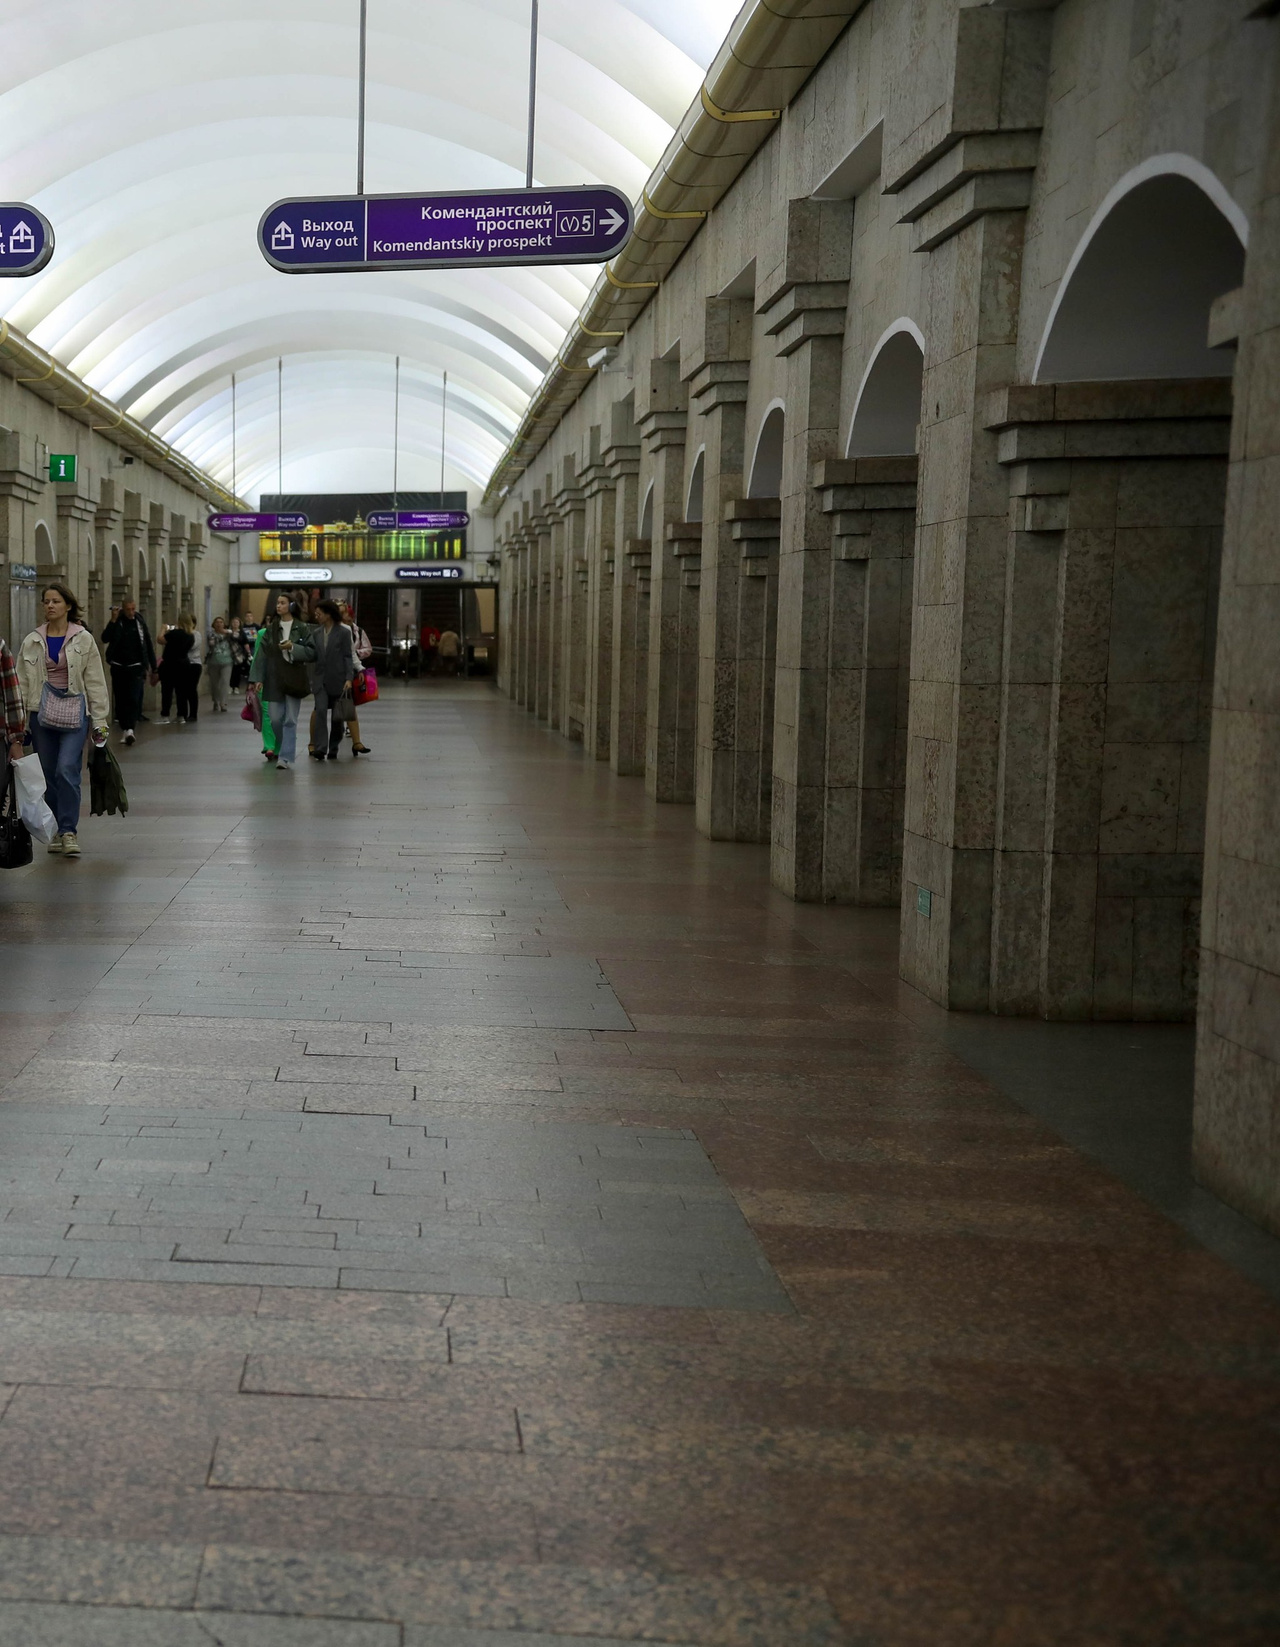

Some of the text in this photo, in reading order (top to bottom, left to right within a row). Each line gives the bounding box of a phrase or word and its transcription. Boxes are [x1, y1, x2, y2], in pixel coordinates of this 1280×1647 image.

[421, 201, 553, 220] Комендантский
[302, 219, 354, 233] Выход
[476, 217, 553, 234] проспект
[300, 235, 359, 251] Way out
[373, 234, 553, 253] Komendantskiy prospekt
